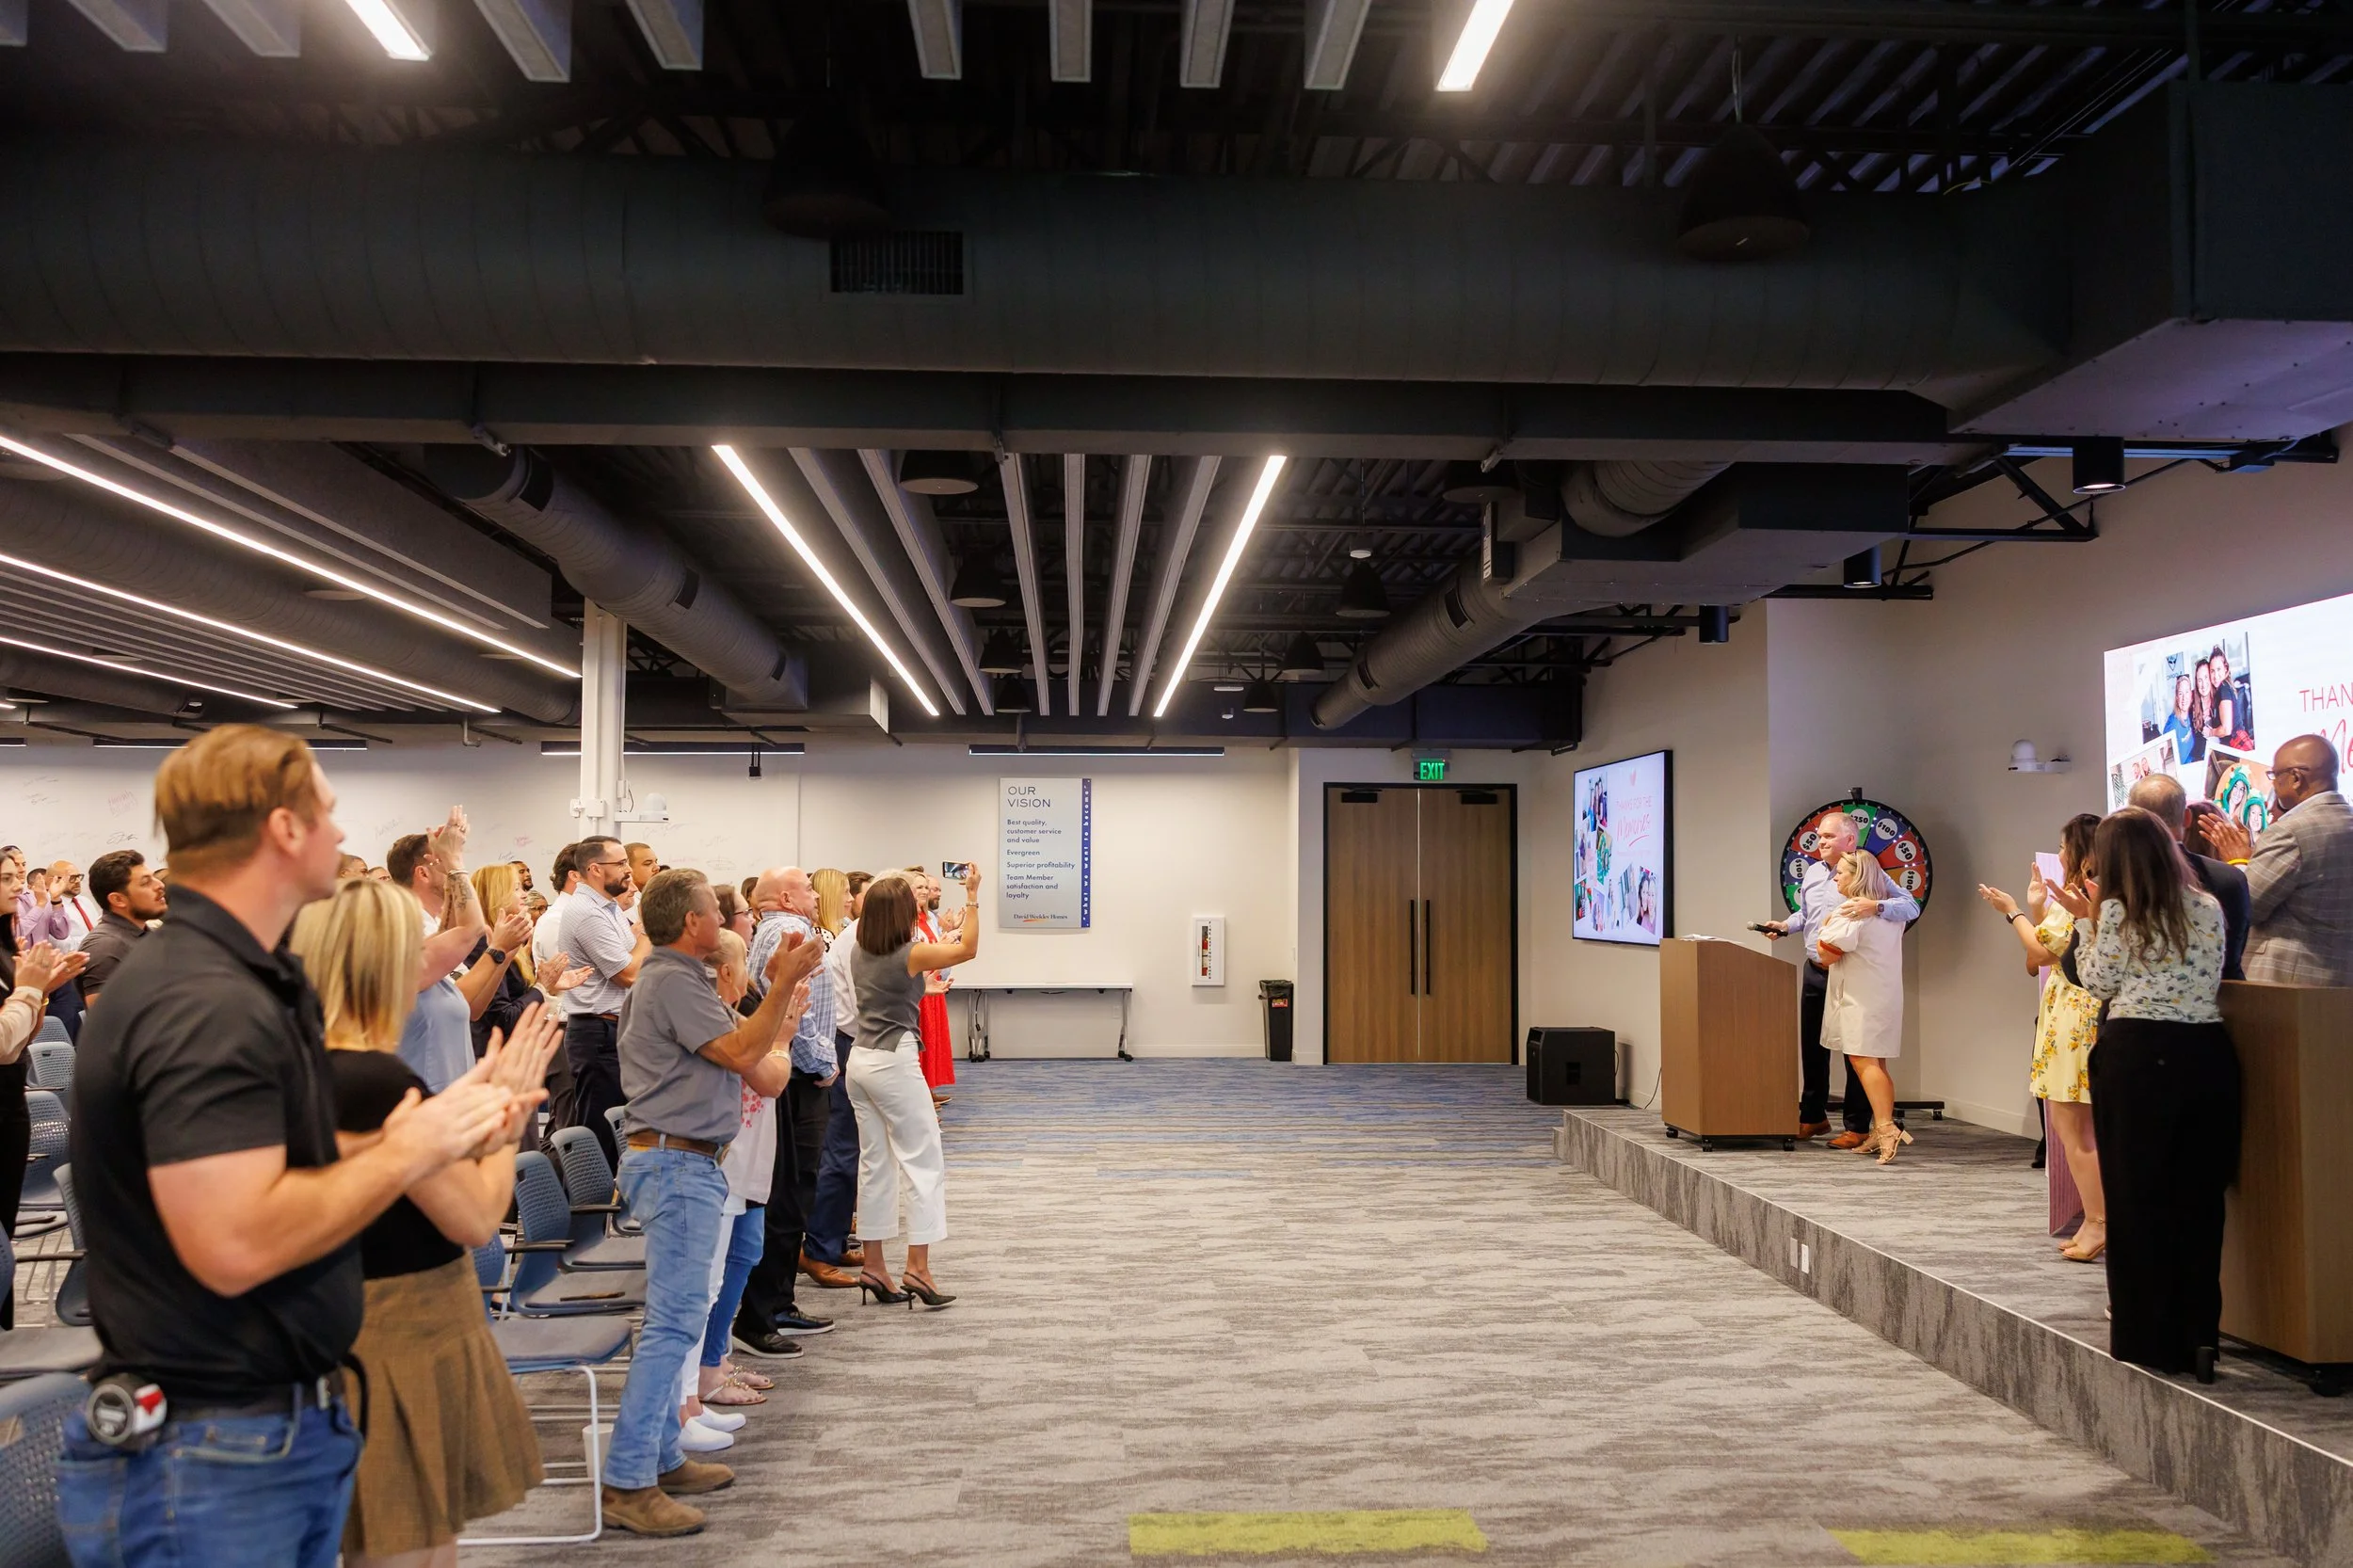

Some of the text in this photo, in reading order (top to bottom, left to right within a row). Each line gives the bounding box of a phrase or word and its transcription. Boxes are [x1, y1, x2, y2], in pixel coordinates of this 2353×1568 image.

[1420, 762, 1445, 780] EXIT
[1008, 786, 1036, 795] OUR
[1007, 798, 1051, 808] VISION
[1022, 818, 1048, 827] quality,
[1850, 814, 1869, 824] 250
[1878, 822, 1896, 837] $100
[1083, 831, 1089, 840] to
[1802, 833, 1817, 850] $50
[1898, 842, 1913, 860] $50
[1036, 861, 1076, 870] profitability
[1795, 858, 1803, 878] $100
[1083, 874, 1089, 887] we
[1906, 871, 1915, 890] $100
[1005, 891, 1030, 900] loyalty
